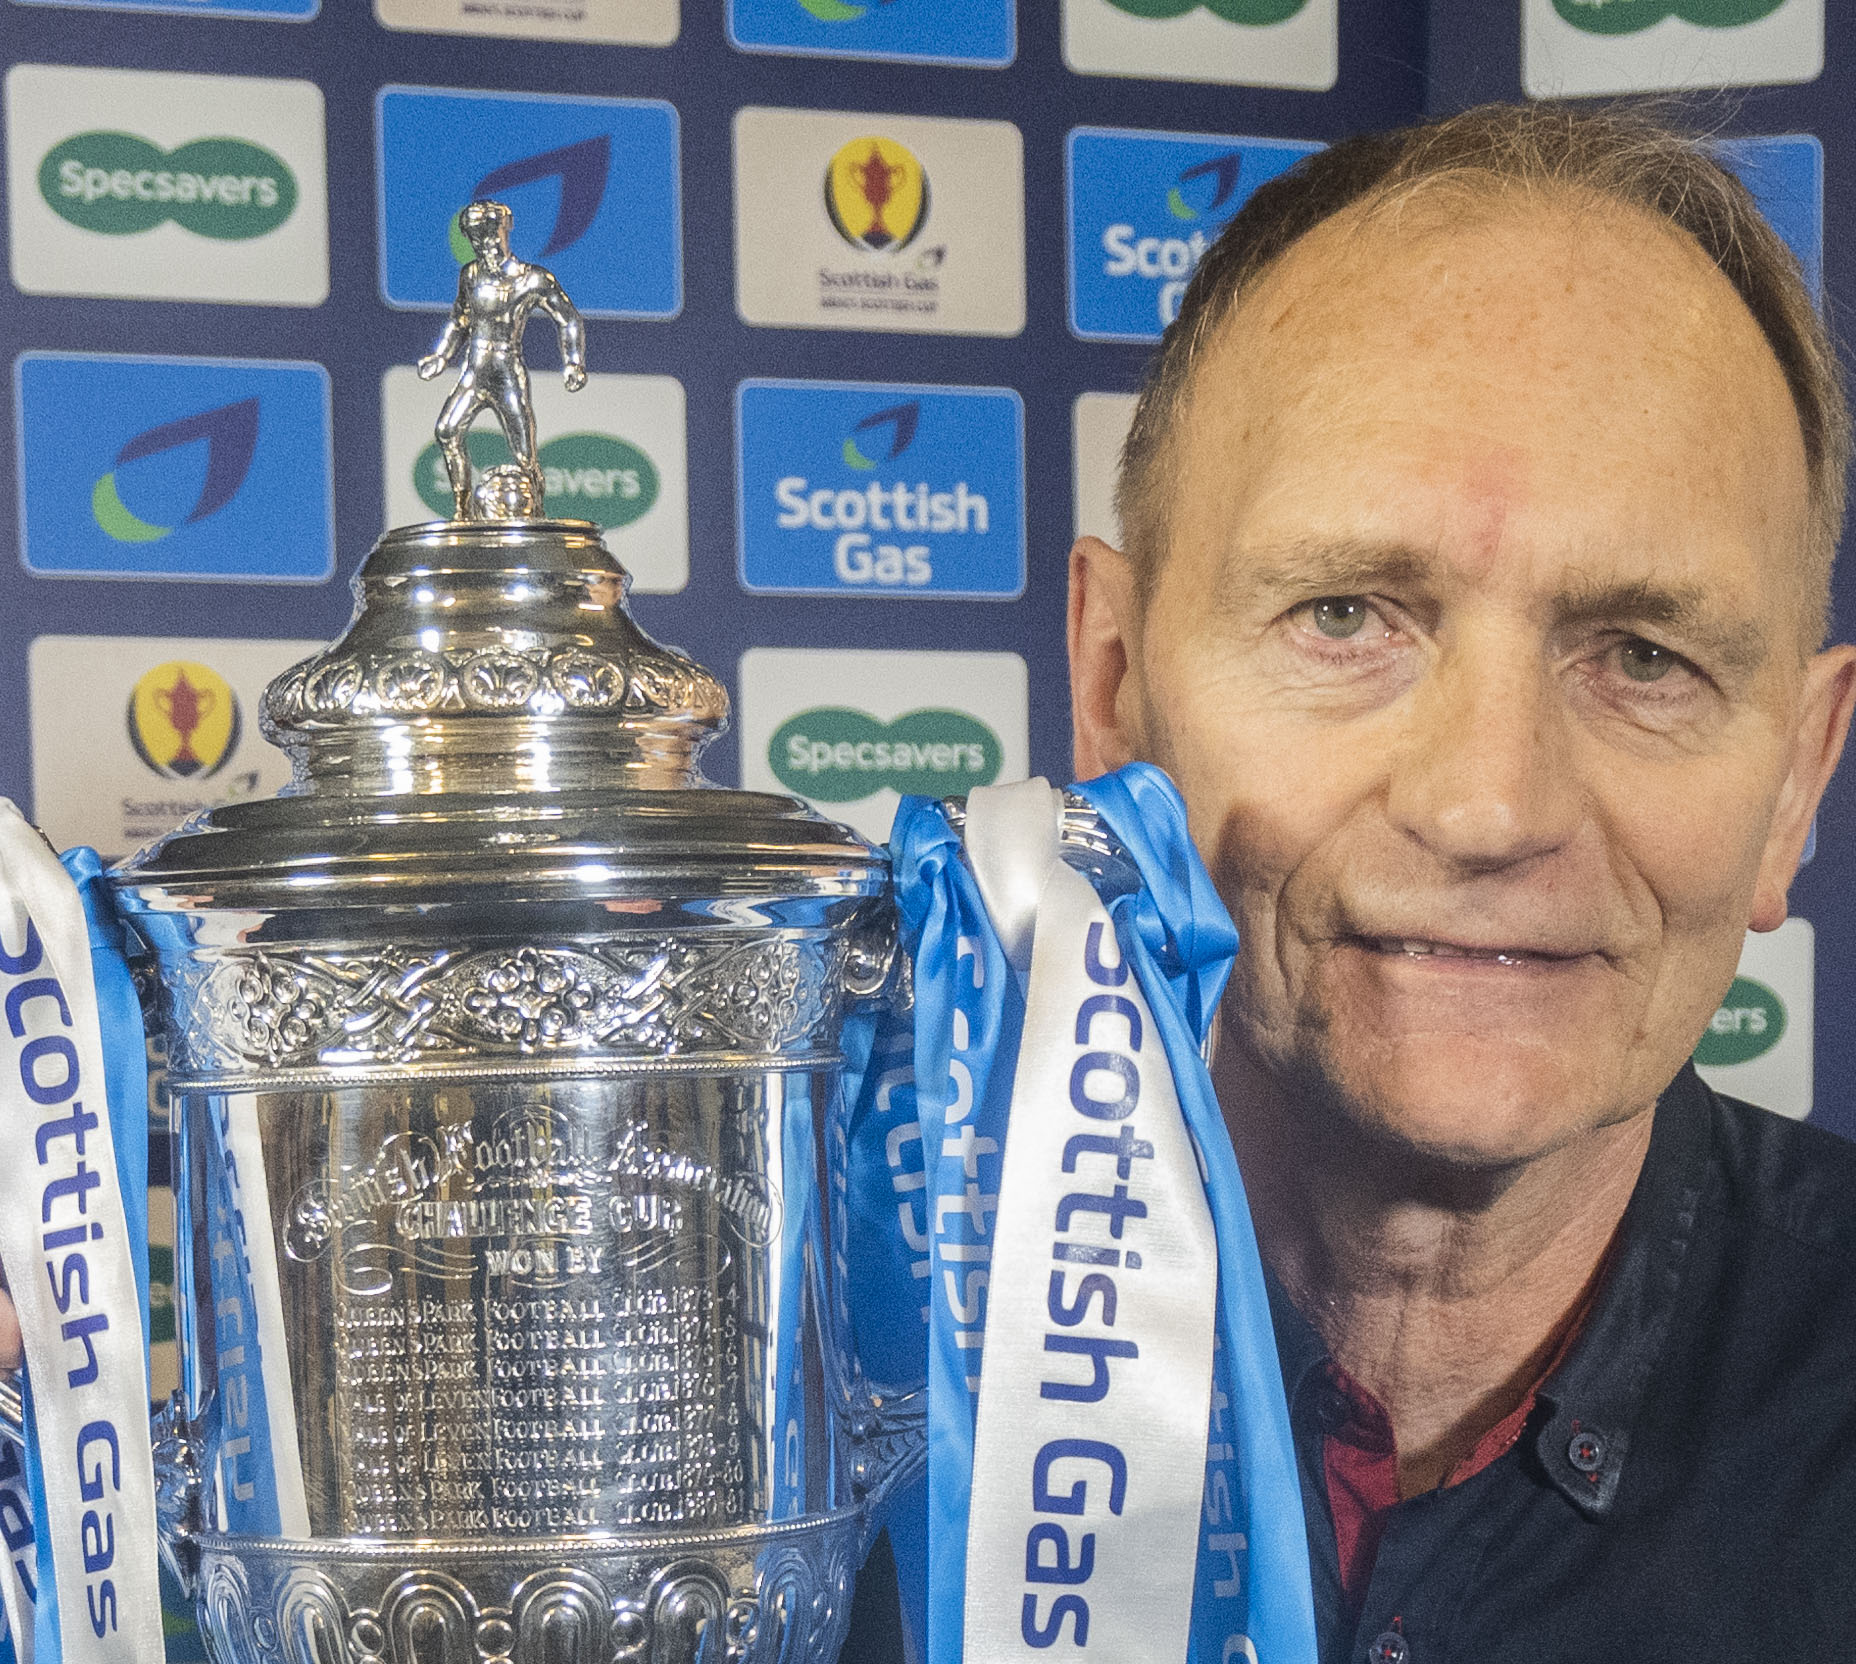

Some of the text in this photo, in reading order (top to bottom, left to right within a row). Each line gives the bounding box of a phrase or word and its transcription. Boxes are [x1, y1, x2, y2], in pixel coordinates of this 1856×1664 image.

[60, 160, 277, 206] Specsavers
[774, 475, 989, 533] Scottish
[833, 530, 933, 580] Gas
[788, 735, 984, 773] Specsavers
[485, 1245, 603, 1278] WON BY
[1020, 920, 1155, 1649] Scottish Gas
[75, 1419, 122, 1641] Gas
